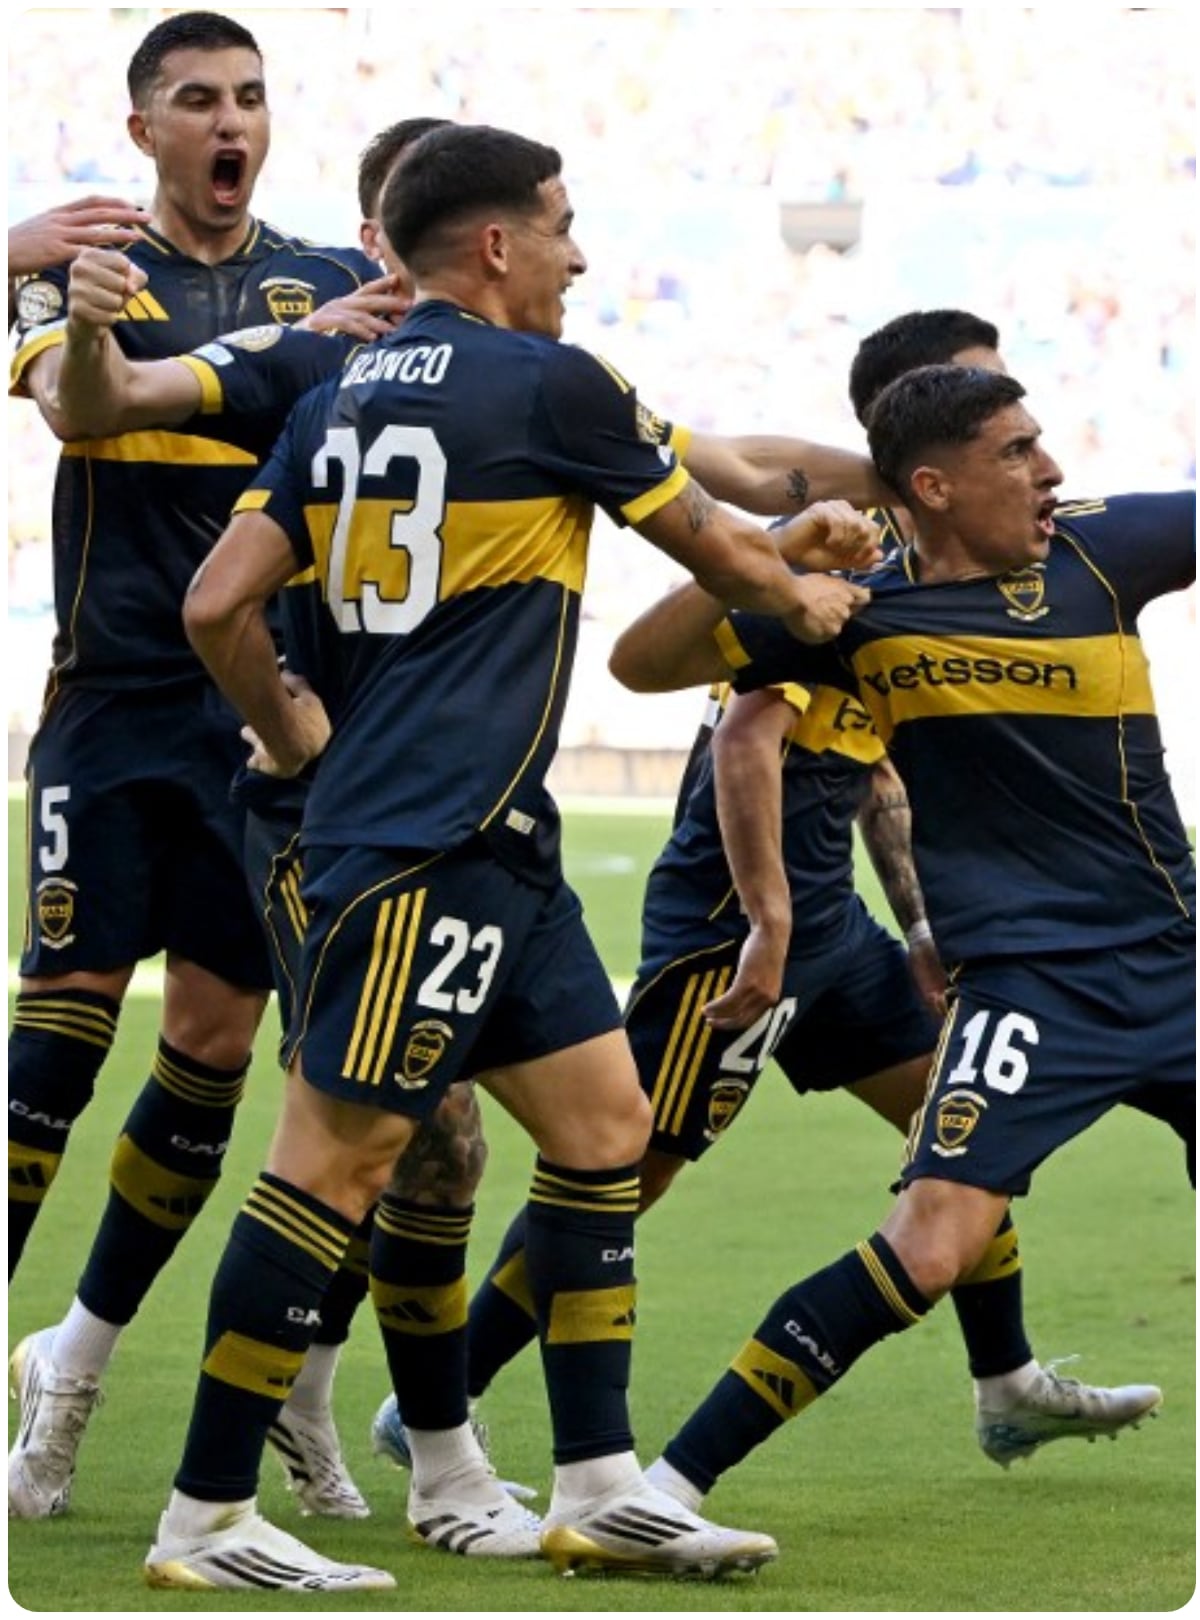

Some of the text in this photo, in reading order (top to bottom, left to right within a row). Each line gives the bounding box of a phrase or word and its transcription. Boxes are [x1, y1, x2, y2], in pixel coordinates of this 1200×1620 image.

[311, 424, 447, 634] 23
[39, 786, 70, 871] 5
[416, 915, 504, 1014] 23
[947, 1009, 1039, 1094] 16
